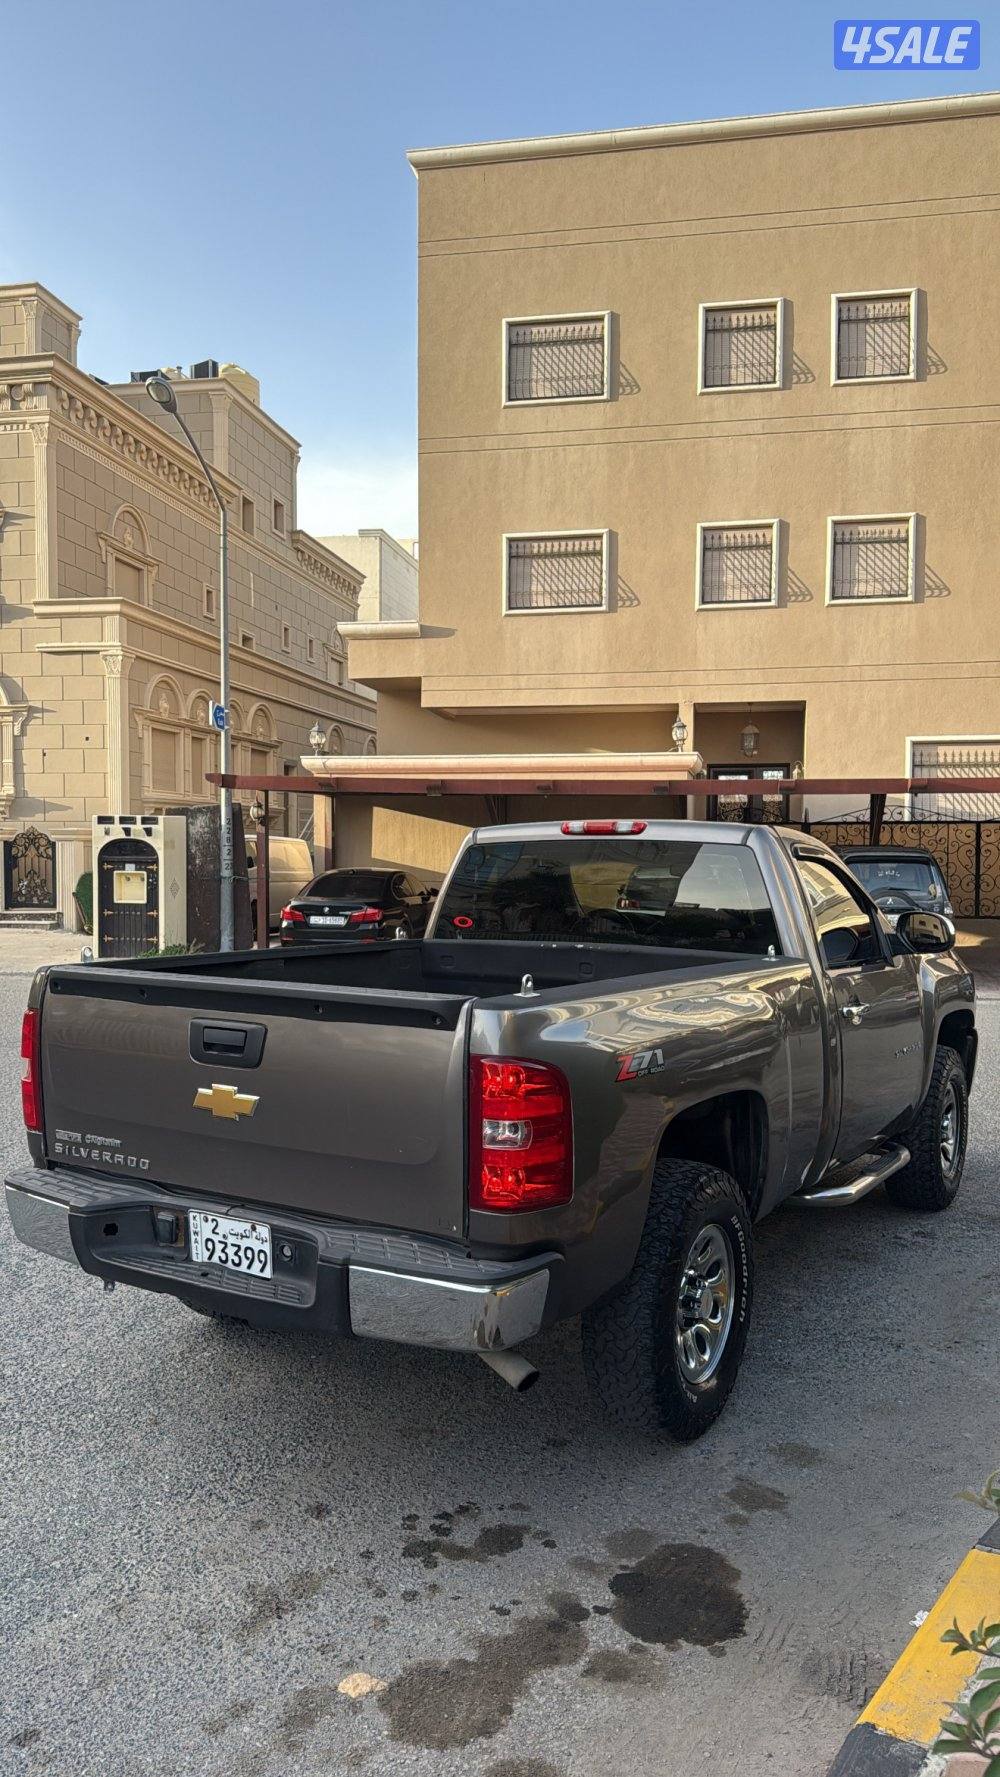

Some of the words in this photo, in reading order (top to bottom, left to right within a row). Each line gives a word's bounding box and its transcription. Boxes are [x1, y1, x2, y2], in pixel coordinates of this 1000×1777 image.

[615, 1049, 664, 1082] Z71
[54, 1142, 150, 1170] SILVERADO
[211, 1218, 220, 1235] 2
[228, 1227, 254, 1240] الكويت
[204, 1237, 268, 1273] 93399
